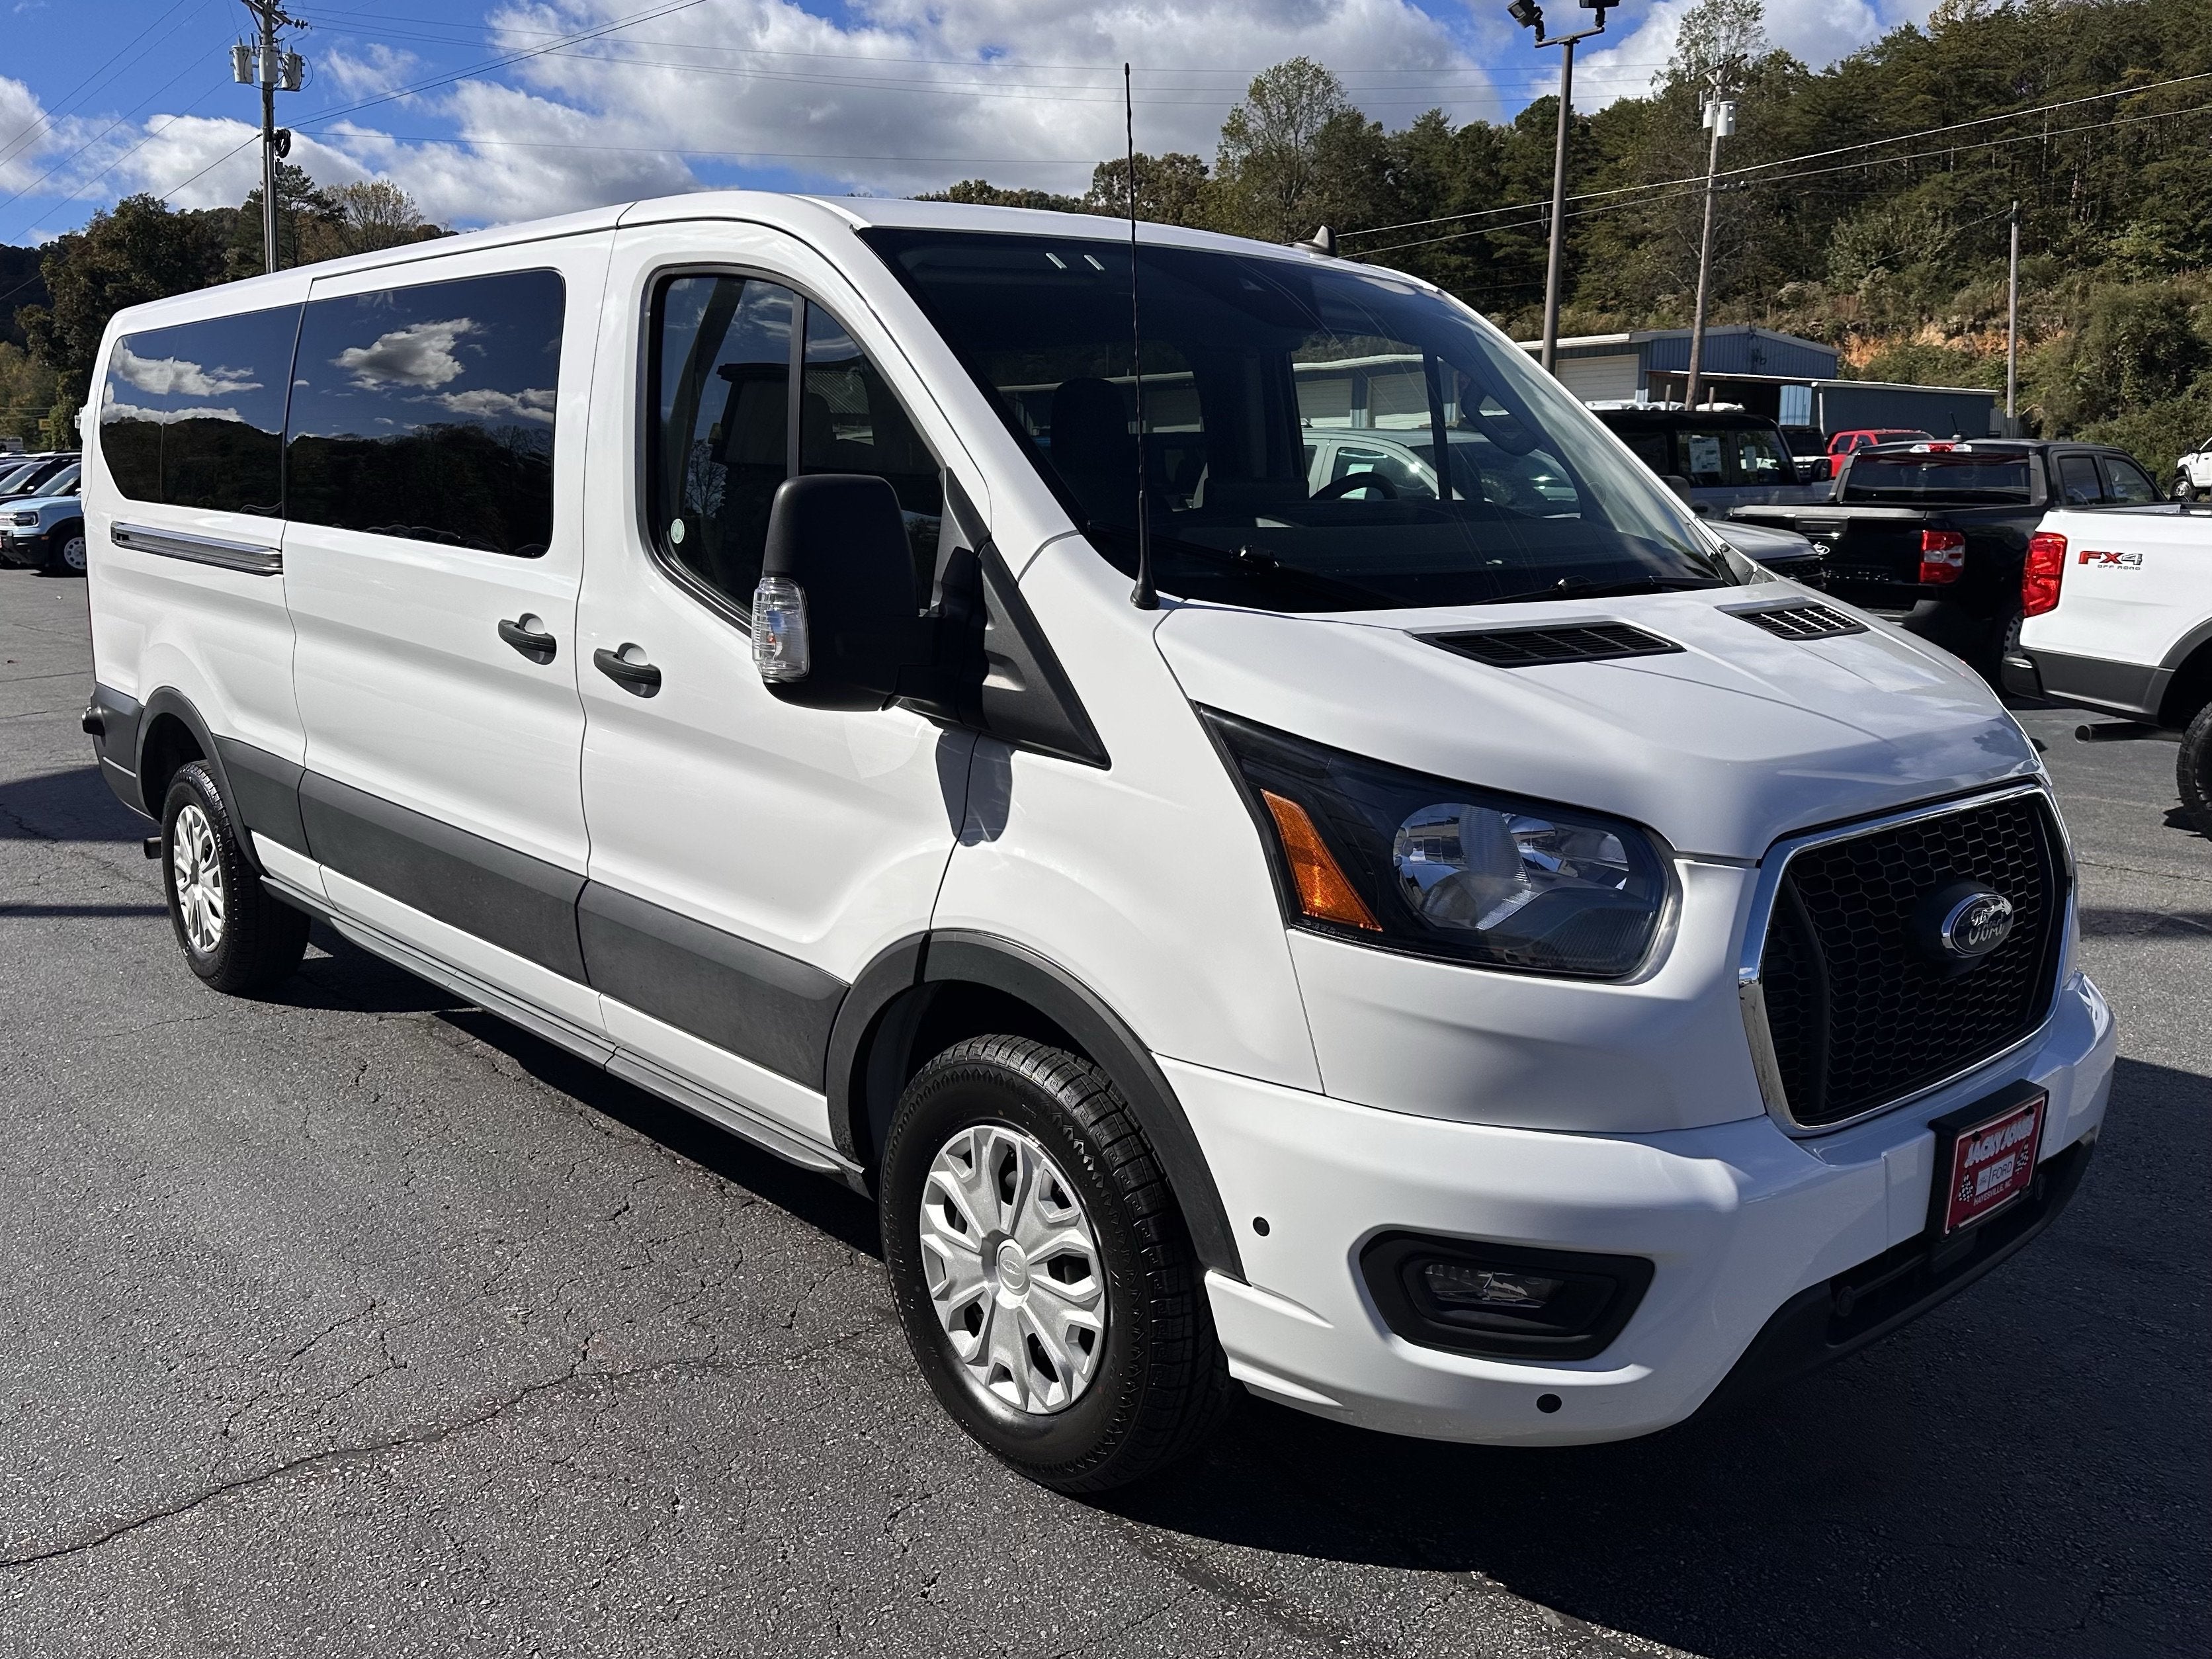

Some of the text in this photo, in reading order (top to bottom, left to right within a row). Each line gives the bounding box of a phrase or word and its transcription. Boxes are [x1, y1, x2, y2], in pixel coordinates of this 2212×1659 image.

[2078, 550, 2143, 565] FX4
[1969, 904, 2004, 945] Ford
[1992, 1162, 2012, 1181] FORD
